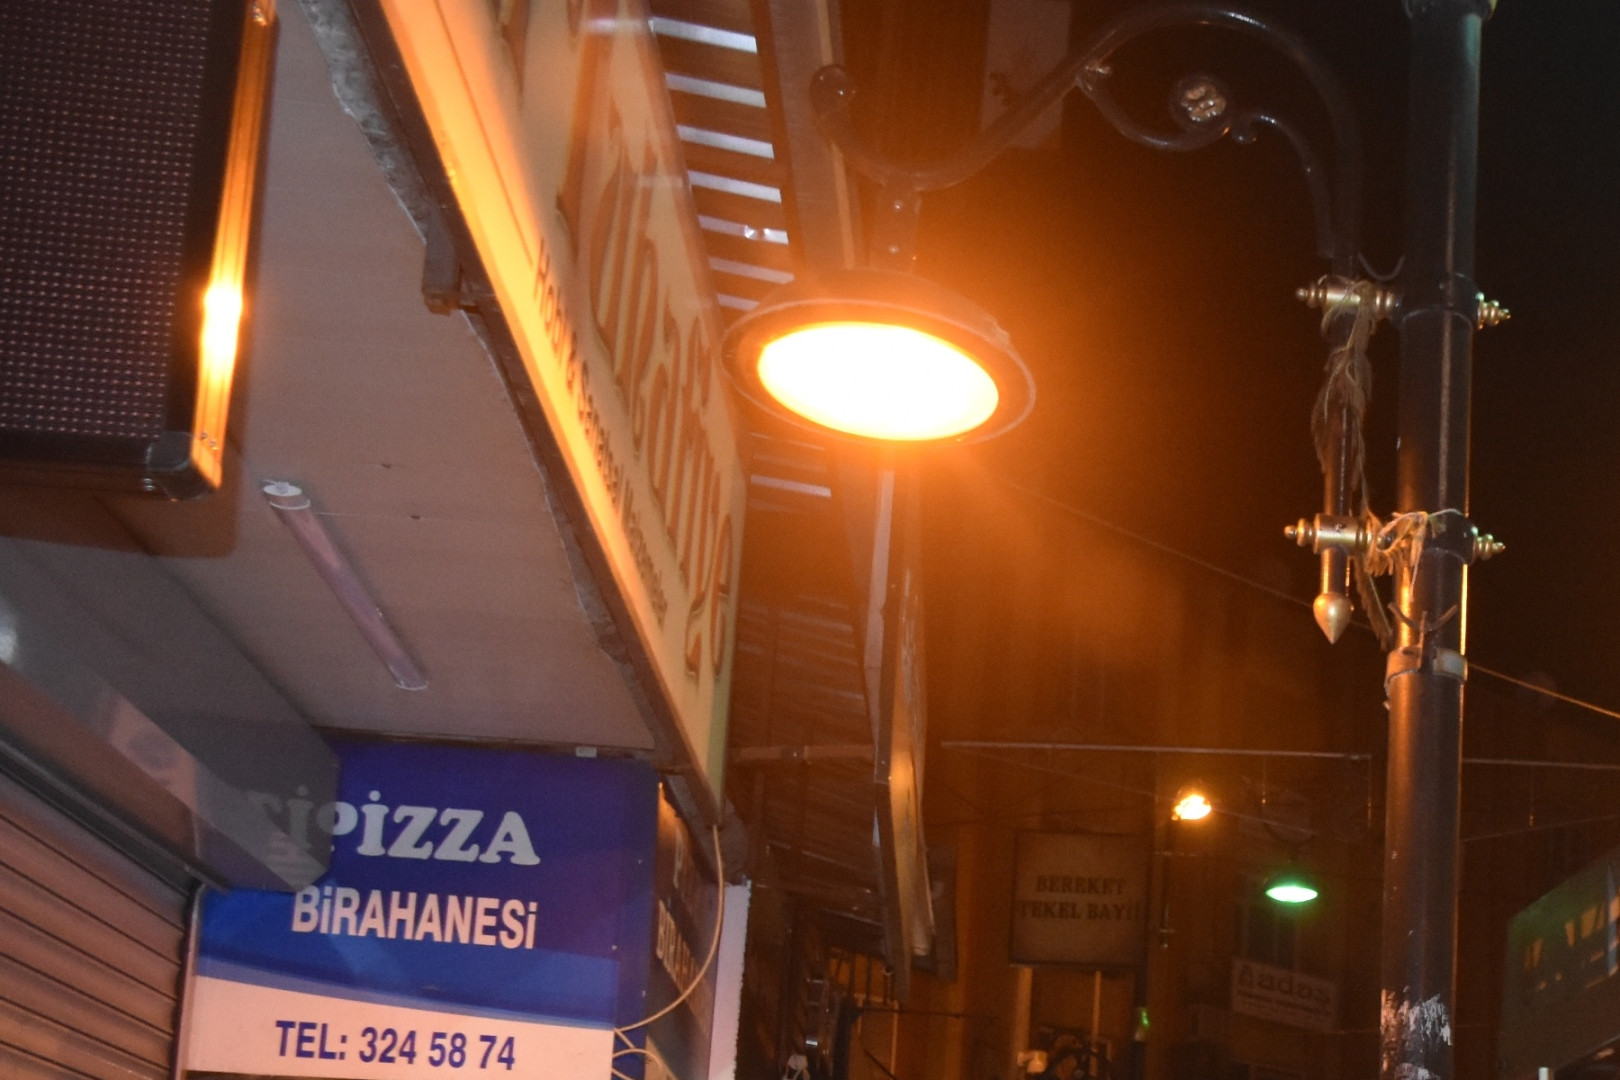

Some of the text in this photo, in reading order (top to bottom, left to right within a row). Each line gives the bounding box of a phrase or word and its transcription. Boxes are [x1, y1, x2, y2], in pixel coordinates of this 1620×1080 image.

[1036, 875, 1126, 896] BEREKET
[292, 886, 538, 950] BİRAHANESİ
[275, 1020, 516, 1072] TEL: 324 58 74
